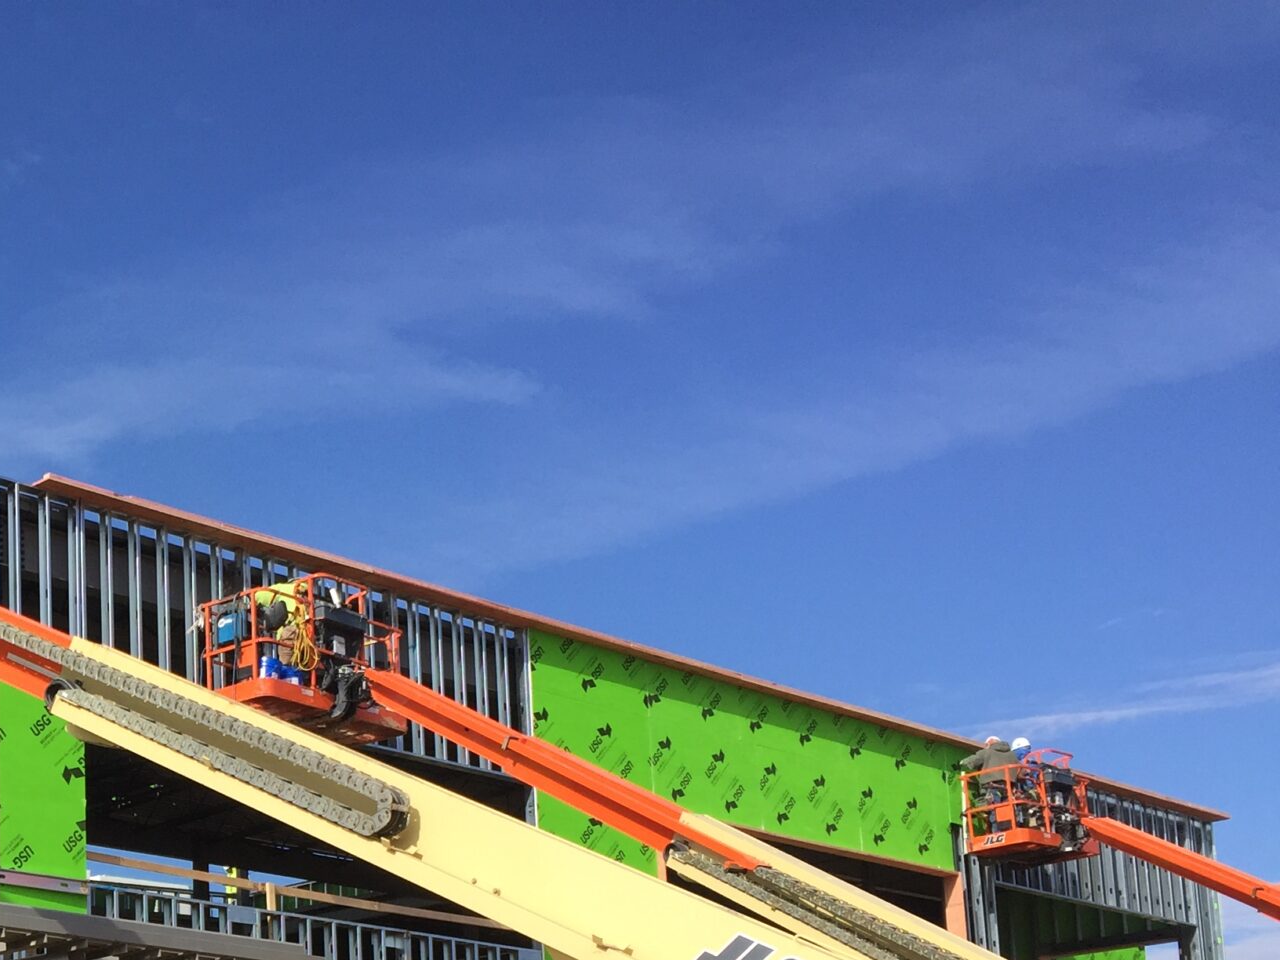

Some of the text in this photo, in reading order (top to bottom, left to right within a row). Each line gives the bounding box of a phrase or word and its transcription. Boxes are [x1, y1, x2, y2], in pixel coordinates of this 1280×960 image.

[30, 713, 52, 737] USG
[589, 735, 603, 753] USG
[705, 761, 717, 779] USG
[680, 772, 693, 789] USG
[62, 829, 83, 854] USG
[580, 826, 594, 844] USG
[984, 833, 1005, 846] JLG
[12, 844, 35, 870] USG
